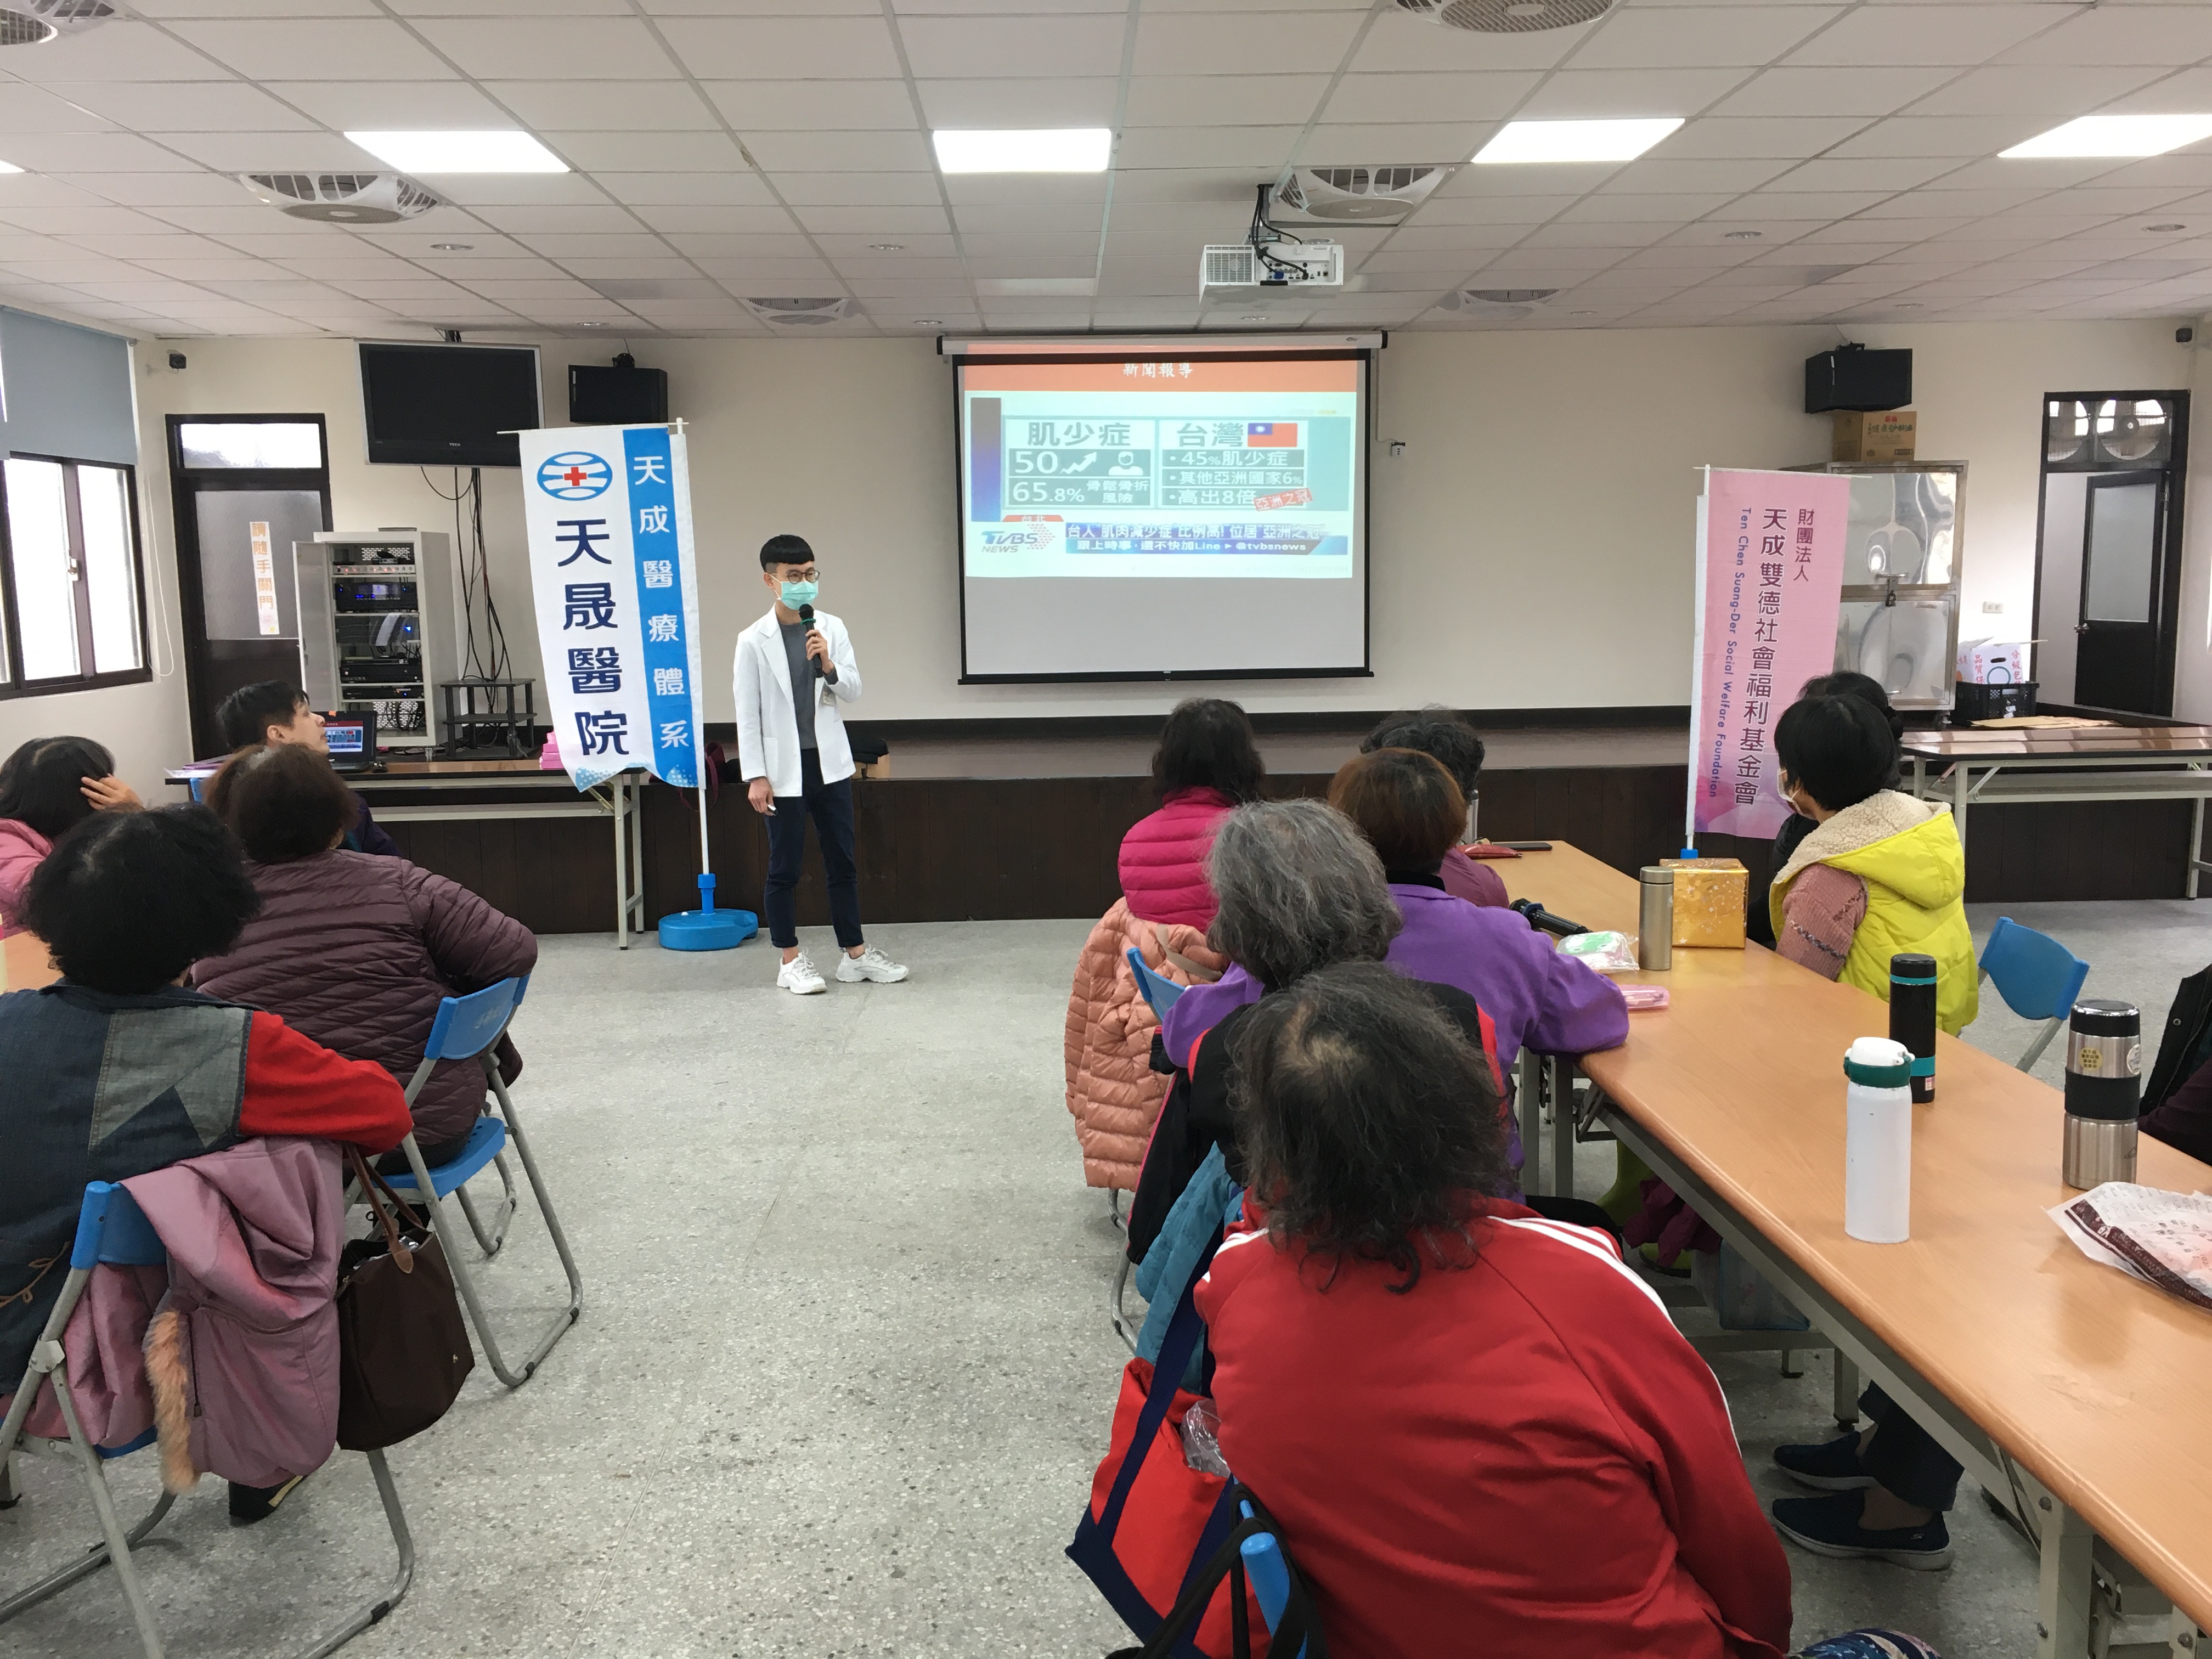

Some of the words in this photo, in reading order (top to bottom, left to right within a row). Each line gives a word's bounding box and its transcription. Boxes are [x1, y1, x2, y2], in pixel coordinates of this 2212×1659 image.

[1122, 362, 1193, 379] 新聞報導
[1027, 422, 1131, 447] 肌少症
[1177, 422, 1244, 447] 台灣
[1015, 451, 1058, 474] 50
[1013, 481, 1085, 503] 65.8%
[1086, 480, 1149, 492] 骨鬆骨折
[1102, 493, 1134, 504] 風險
[1178, 489, 1256, 505] 高出8倍
[1255, 489, 1311, 511] 亞洲之冠
[1740, 507, 1752, 529] Ten
[981, 531, 1039, 545] TVBS
[981, 545, 1019, 554] NEWS
[1736, 535, 1749, 566] Chen
[1793, 508, 1815, 582] 財團法人
[251, 522, 274, 610] 請隨手關門
[633, 455, 690, 748] 天成醫療體系
[1729, 572, 1745, 634] Suang-Der
[555, 518, 630, 755] 天晟醫院
[1724, 640, 1737, 675] Social
[1734, 507, 1788, 805] 天成雙德社會福利基金會
[1717, 680, 1733, 729] Welfare
[1709, 733, 1726, 798] Foundation
